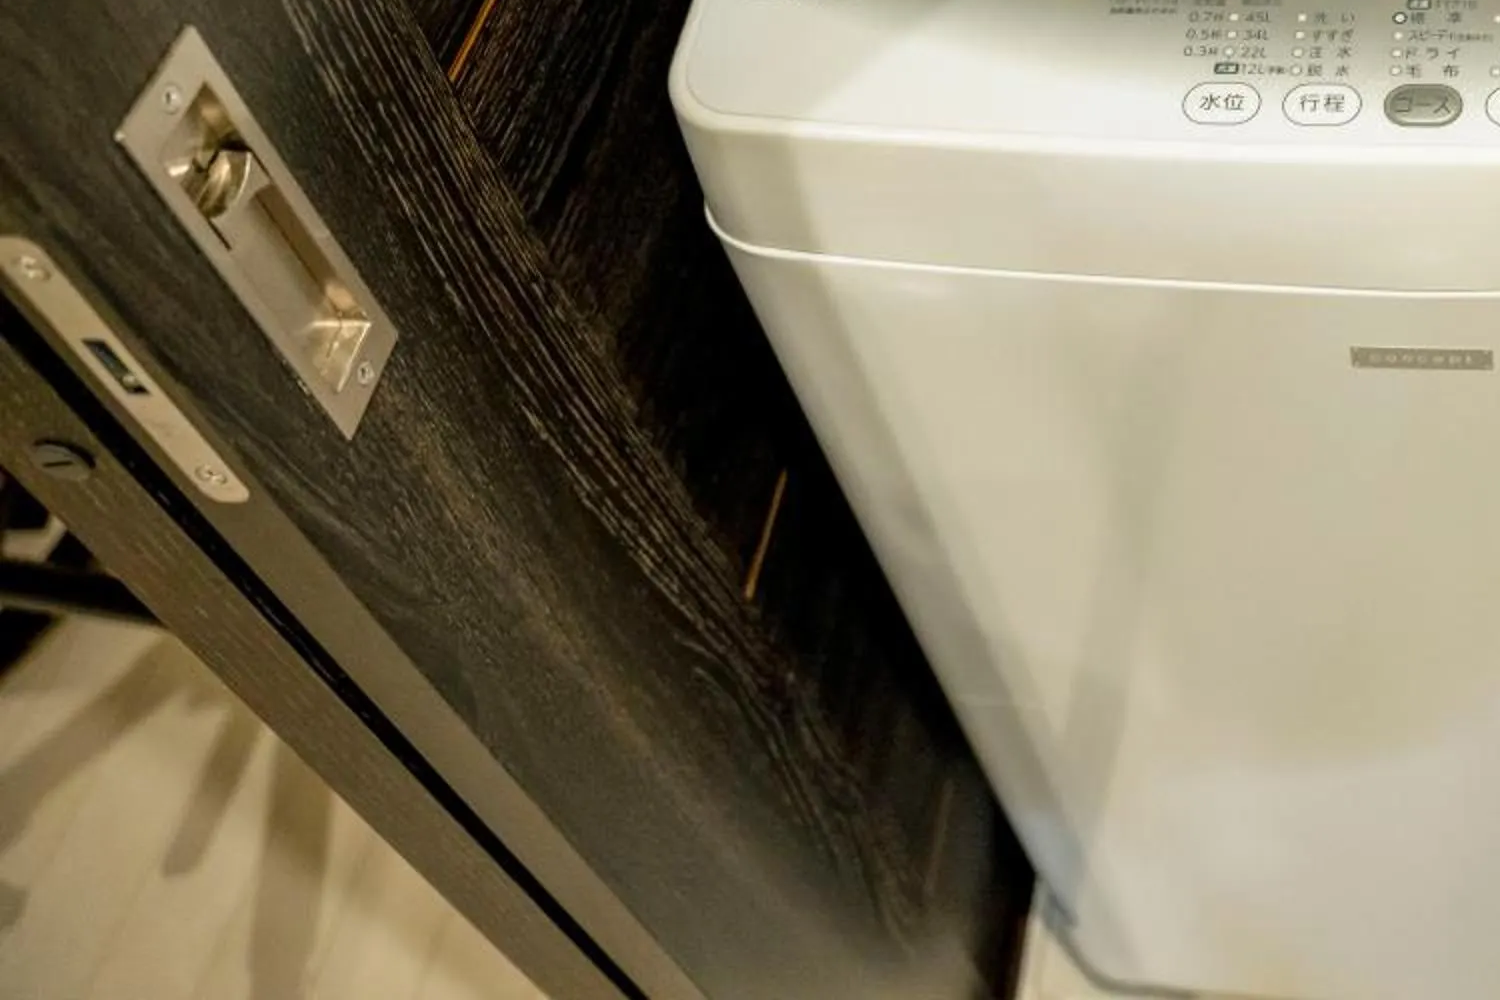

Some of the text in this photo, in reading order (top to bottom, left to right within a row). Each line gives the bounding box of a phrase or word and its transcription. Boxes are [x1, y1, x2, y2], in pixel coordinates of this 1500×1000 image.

[1244, 11, 1271, 23] 45L
[1240, 46, 1268, 59] 22L
[1404, 46, 1461, 60] ドライ
[1199, 94, 1245, 111] 水位
[1299, 94, 1346, 113] 行程
[1394, 96, 1453, 114] コース
